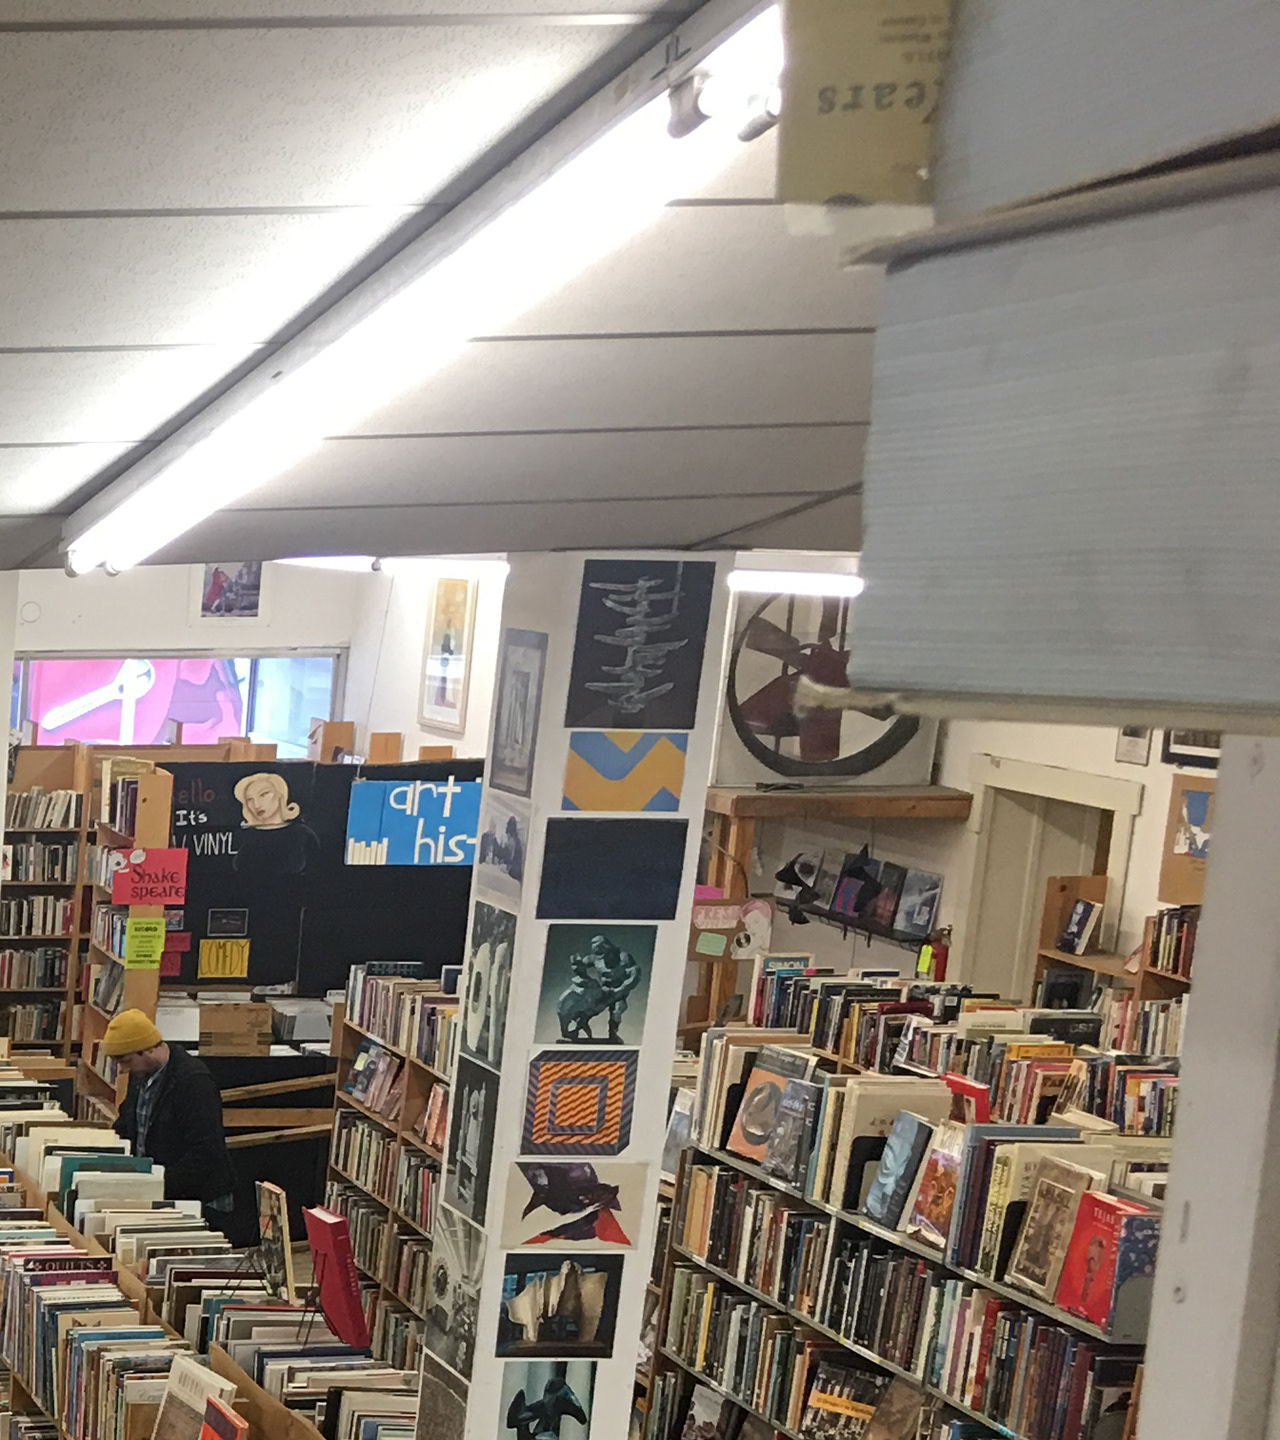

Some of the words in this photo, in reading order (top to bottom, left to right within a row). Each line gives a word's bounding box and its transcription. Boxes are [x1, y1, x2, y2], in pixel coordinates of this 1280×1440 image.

[389, 775, 461, 817] art
[175, 810, 208, 826] It's
[193, 832, 239, 855] VINYL
[413, 817, 477, 864] his
[131, 863, 179, 884] Shake
[130, 885, 185, 901] speare
[200, 940, 250, 976] COMEDY
[45, 1259, 95, 1272] QUILTS
